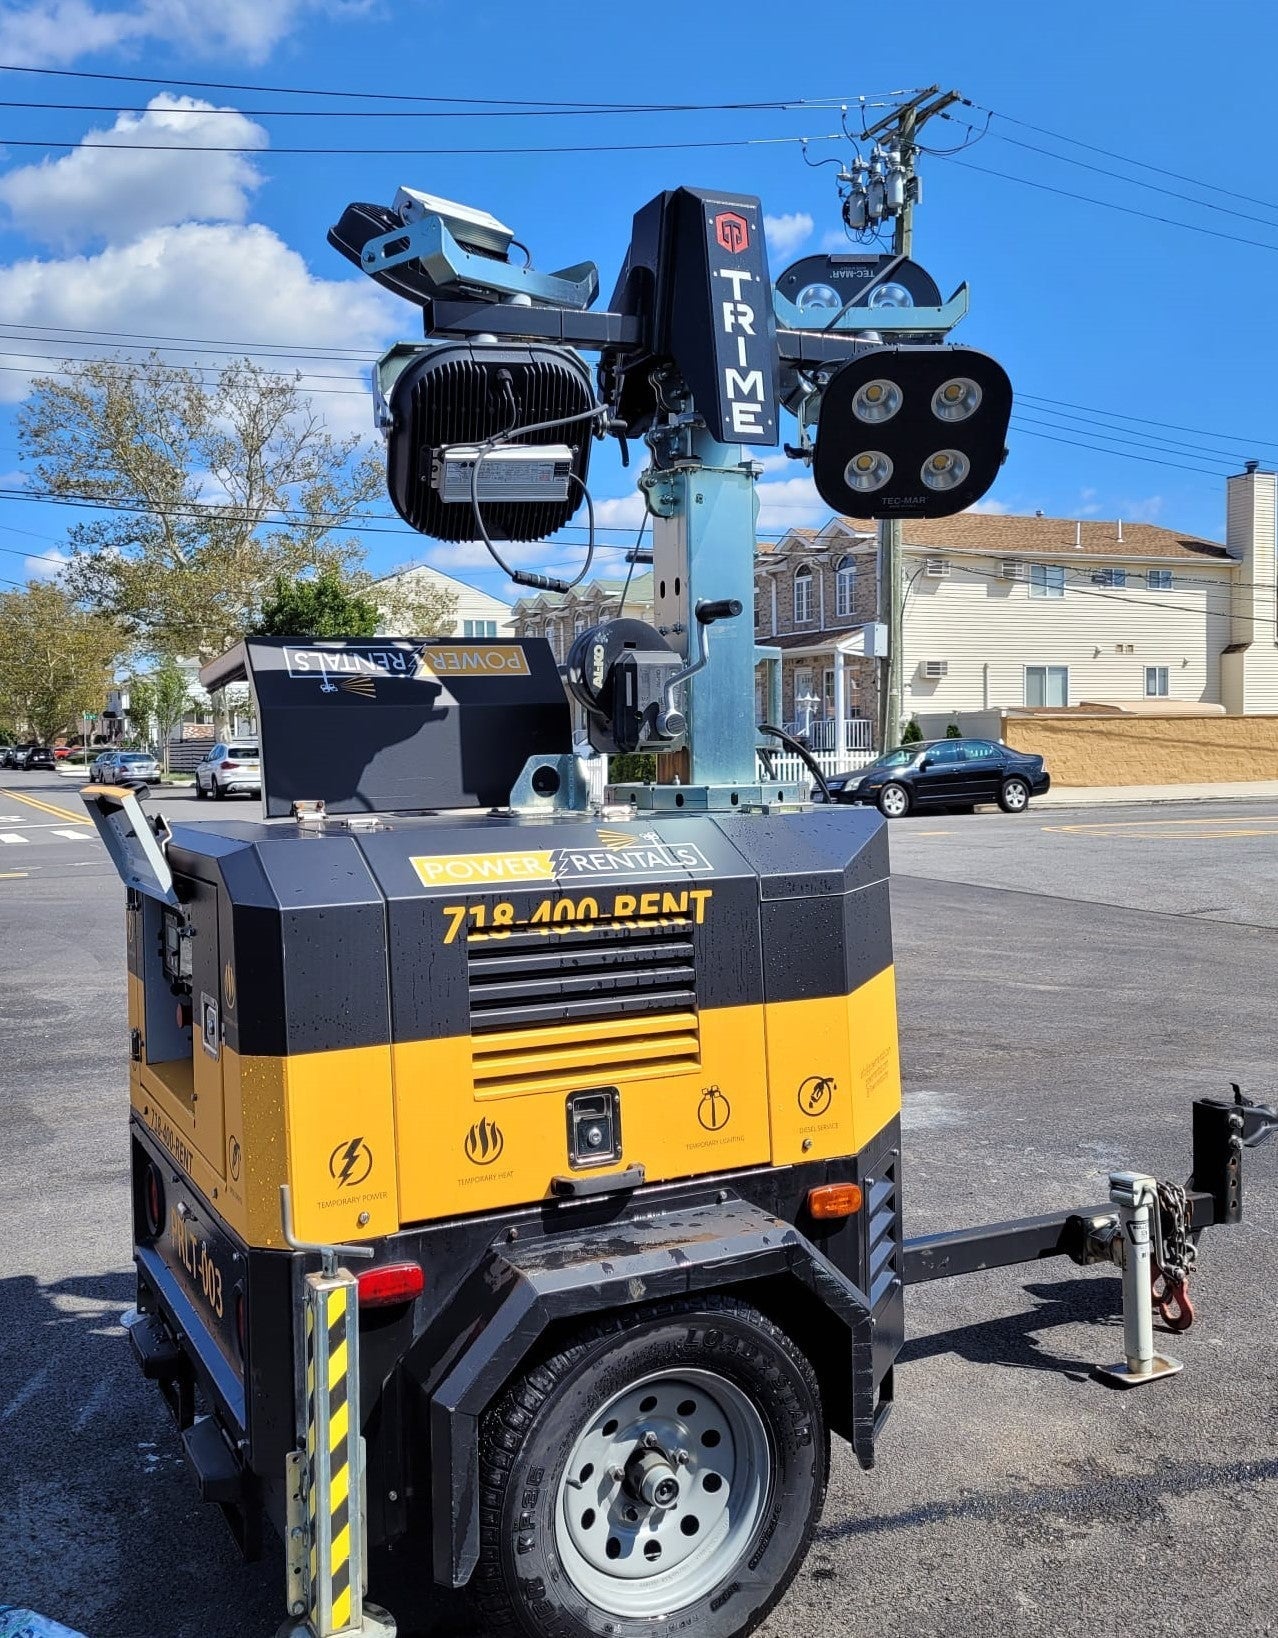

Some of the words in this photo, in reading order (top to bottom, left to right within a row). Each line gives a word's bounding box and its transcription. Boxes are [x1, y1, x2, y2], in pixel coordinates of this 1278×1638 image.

[832, 269, 875, 279] TEC-MAR
[720, 269, 765, 434] TRIME
[881, 496, 926, 505] TEC-MAR
[295, 652, 405, 671] RENTALS
[433, 652, 520, 670] POWER
[592, 644, 605, 689] AL-KO
[426, 857, 546, 879] POWER
[571, 849, 697, 871] RENTALS
[443, 890, 713, 944] 718-400-RENT
[458, 1174, 496, 1186] TEMPORARY
[317, 1194, 360, 1209] TEMPORARY
[362, 1191, 388, 1202] POWER
